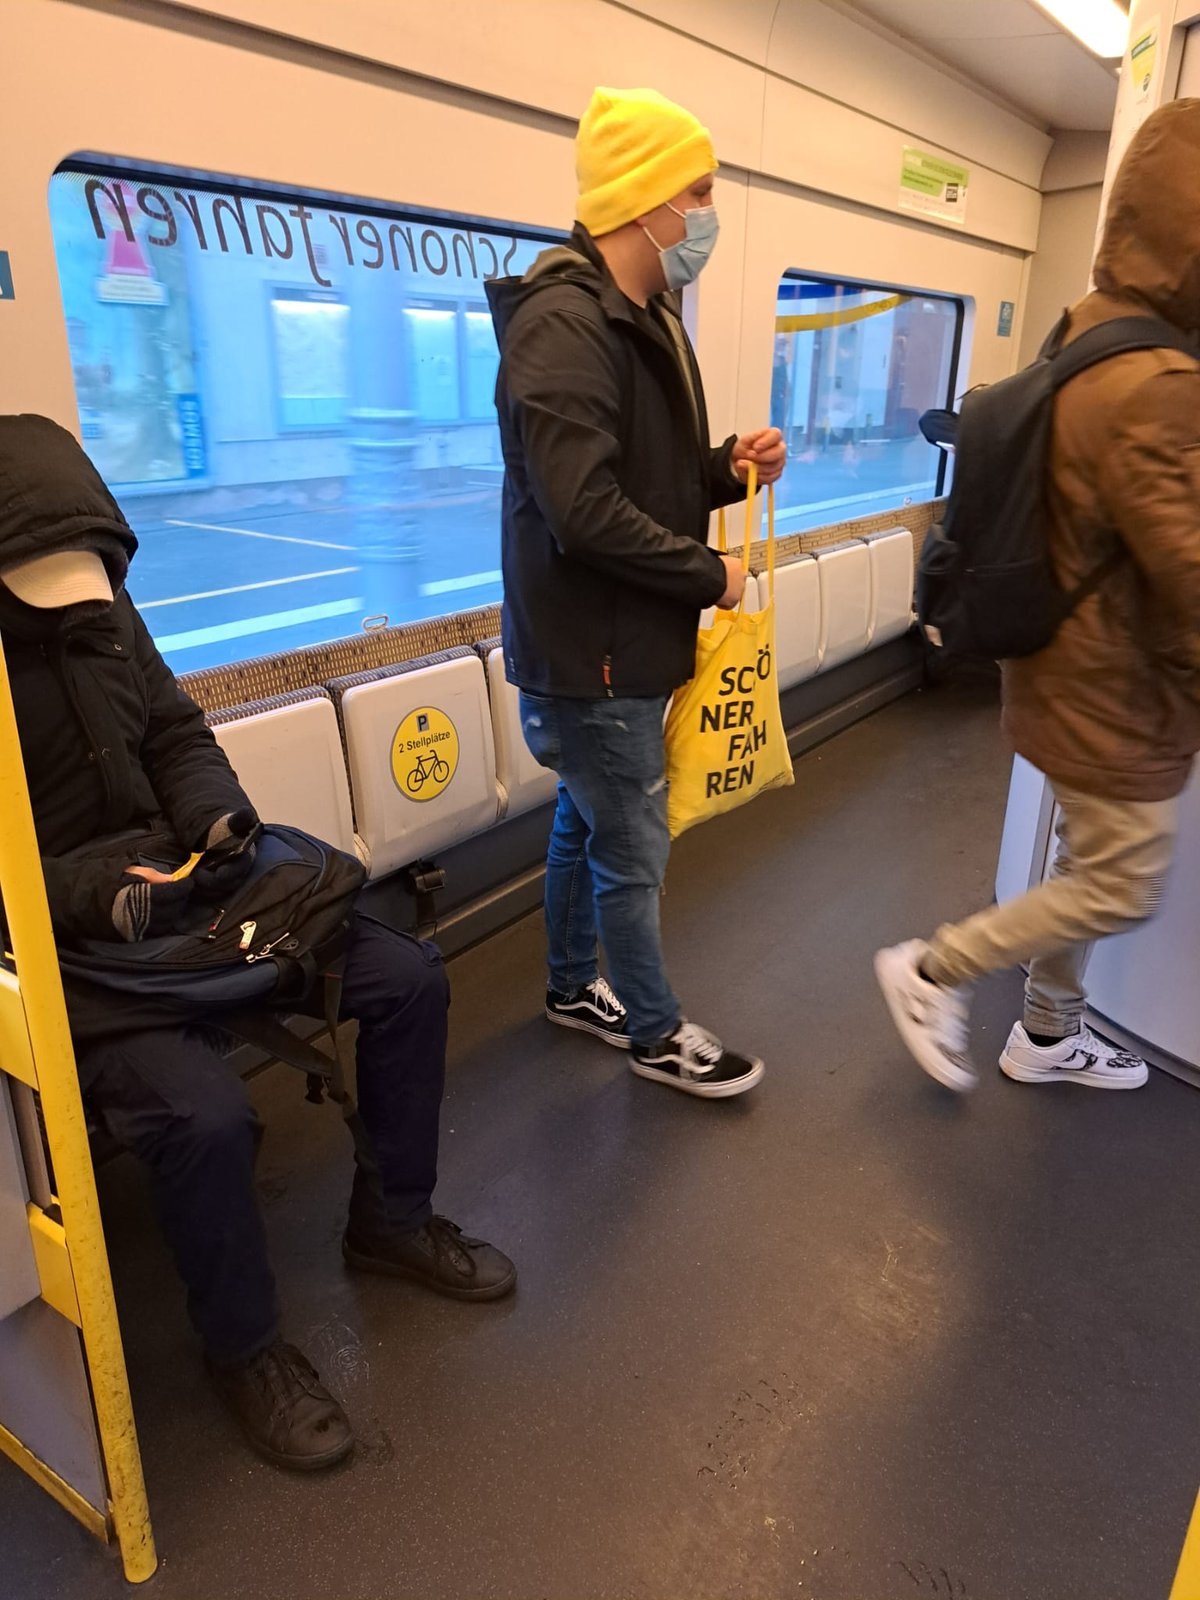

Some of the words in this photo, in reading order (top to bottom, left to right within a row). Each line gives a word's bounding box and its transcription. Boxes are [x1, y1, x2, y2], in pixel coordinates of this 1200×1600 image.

[417, 715, 427, 731] P
[699, 700, 755, 733] NER
[398, 743, 404, 753] 2
[407, 731, 450, 750] Stellplätze
[727, 719, 767, 762] FAH
[706, 760, 755, 798] REN
